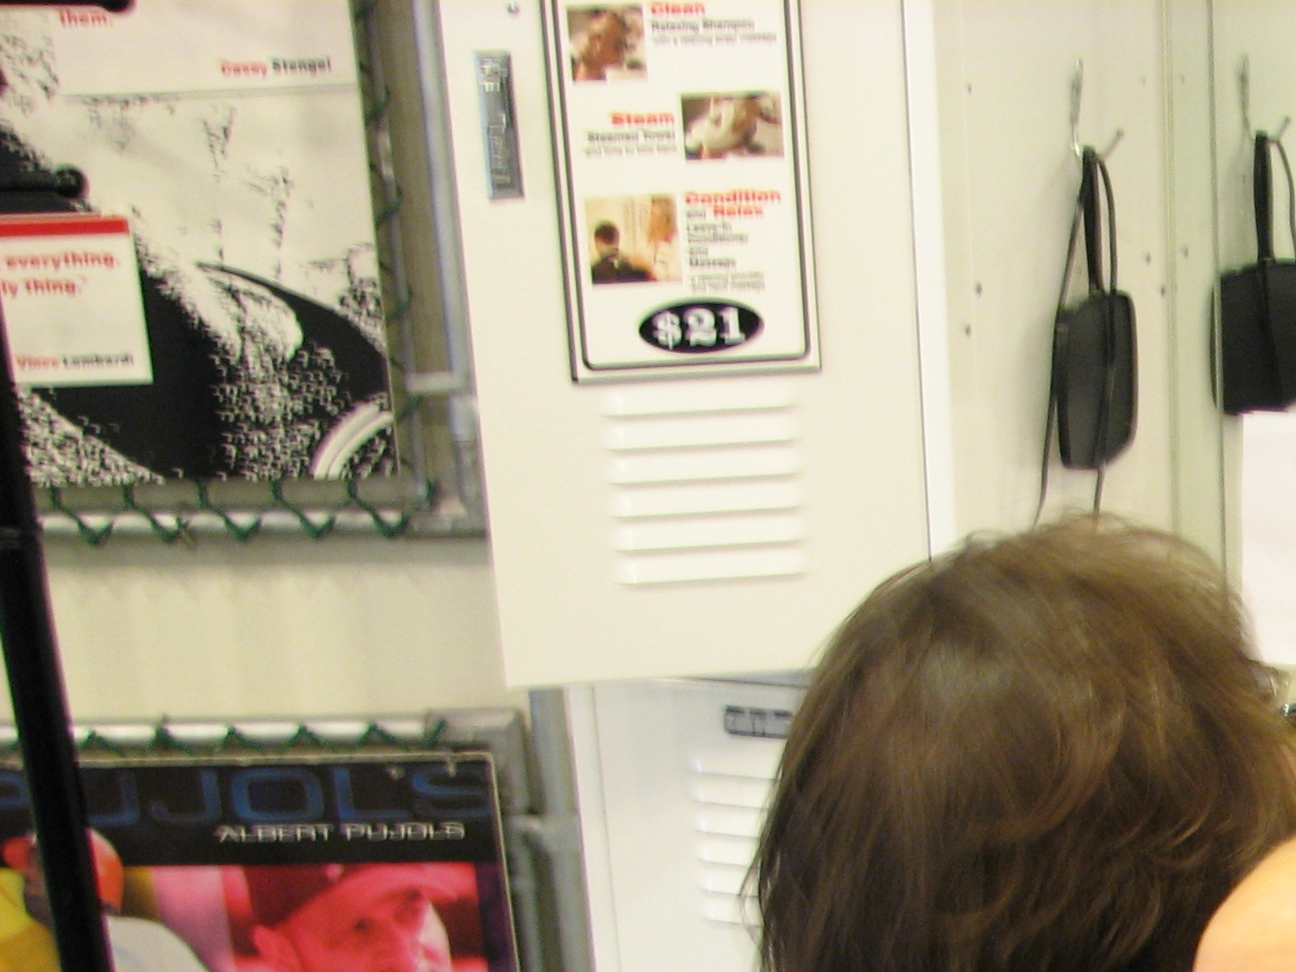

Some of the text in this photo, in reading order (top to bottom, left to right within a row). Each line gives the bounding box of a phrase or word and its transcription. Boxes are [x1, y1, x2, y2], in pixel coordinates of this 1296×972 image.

[650, 1, 706, 16] Clean
[271, 56, 332, 77] Stengel
[610, 111, 675, 126] Steam
[684, 189, 782, 206] Condition
[713, 204, 764, 219] Relax
[651, 305, 747, 350] $21
[62, 352, 135, 369] Lombardi
[216, 821, 466, 843] ALBERT PUJOLS
